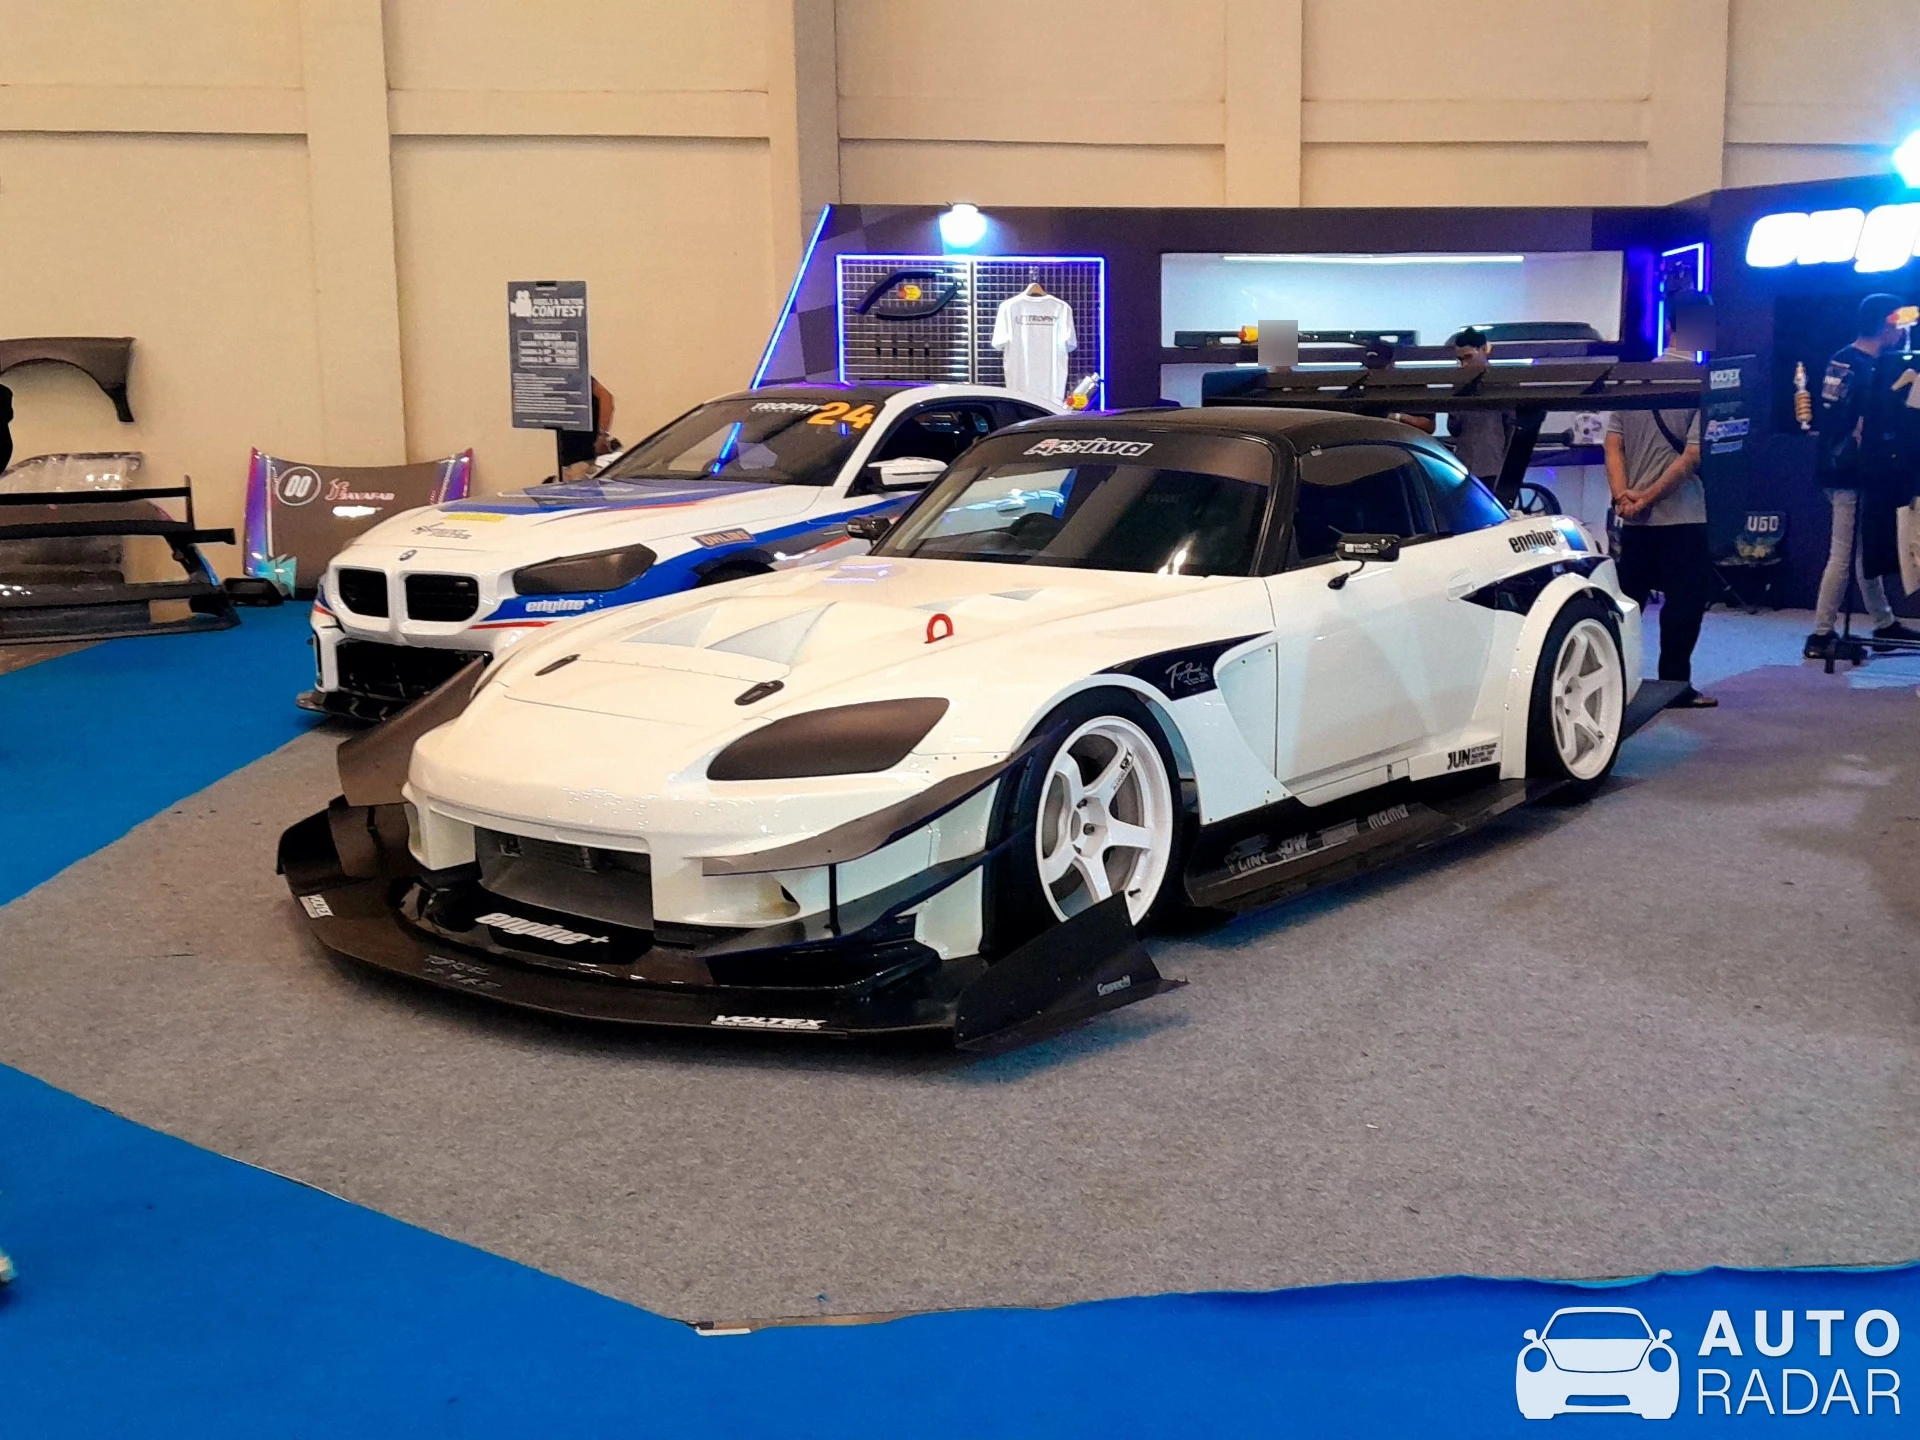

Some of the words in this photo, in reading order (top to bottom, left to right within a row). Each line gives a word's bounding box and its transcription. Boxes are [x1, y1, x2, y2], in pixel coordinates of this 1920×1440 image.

[532, 305, 585, 317] CONTEST
[807, 401, 875, 429] 24
[1447, 748, 1471, 770] JUN
[716, 1015, 828, 1027] VOLTEX
